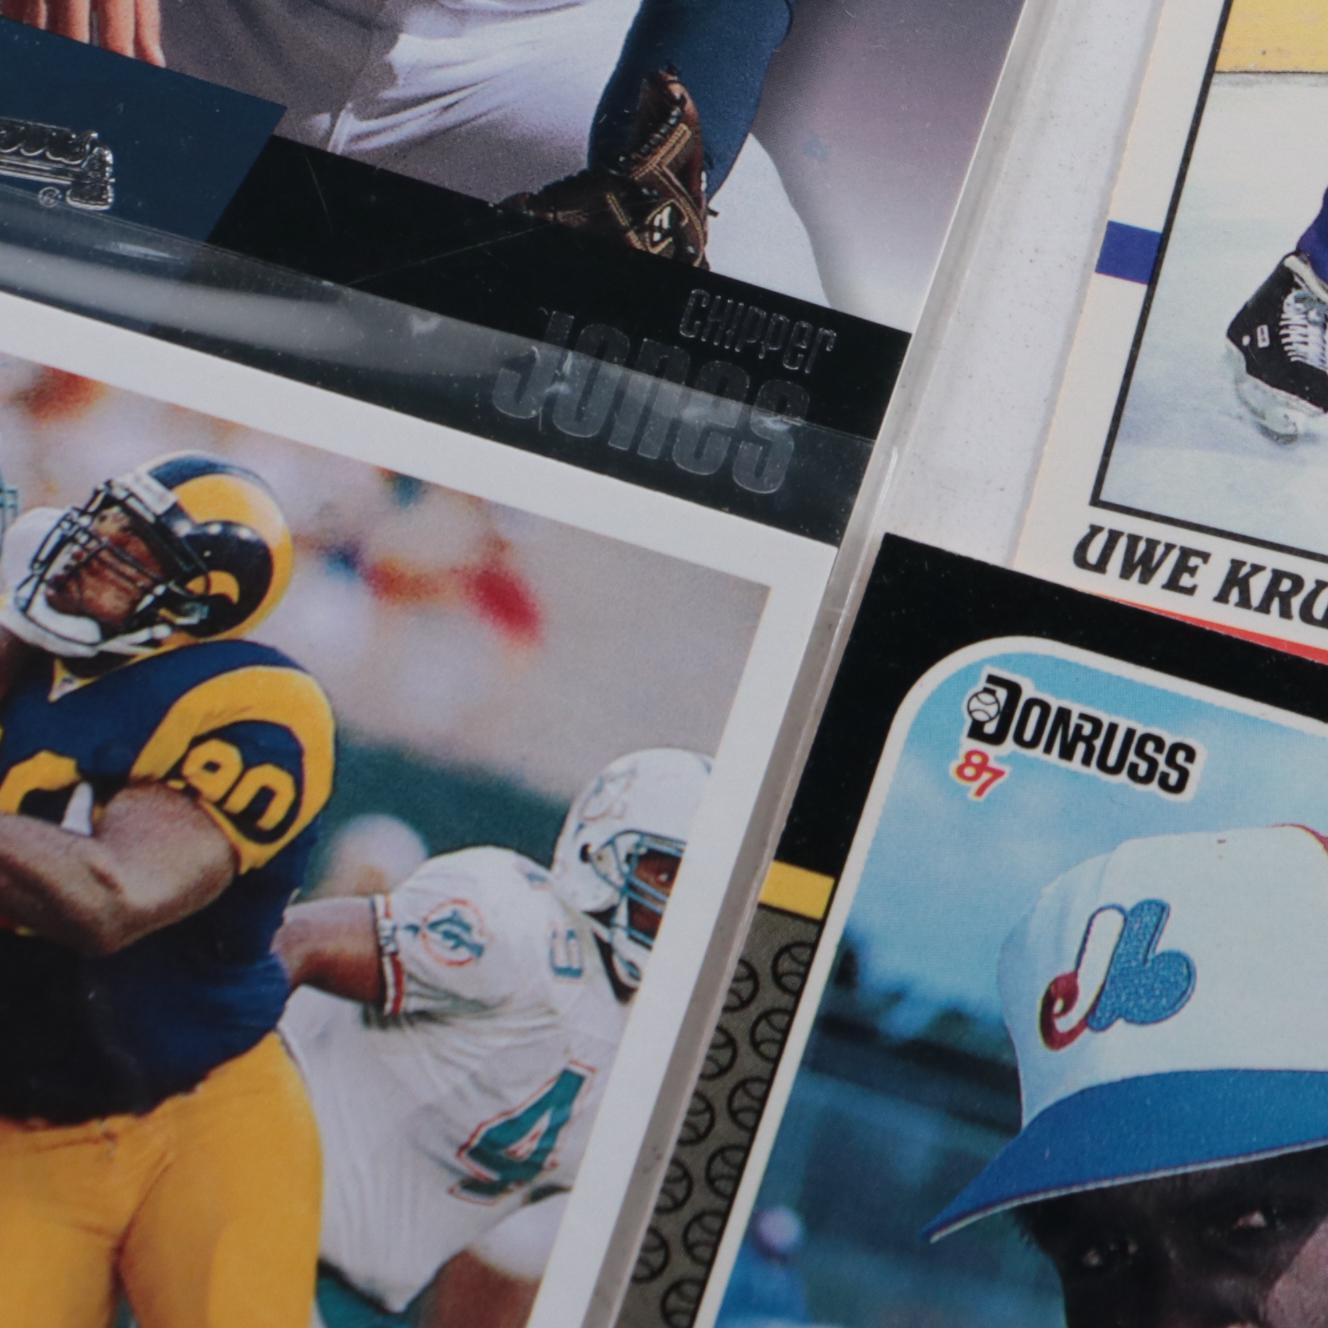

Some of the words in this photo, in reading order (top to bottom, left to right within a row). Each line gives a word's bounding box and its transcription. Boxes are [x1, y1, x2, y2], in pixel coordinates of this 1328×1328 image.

[1072, 523, 1212, 597] UWE
[967, 673, 1198, 795] DONRUSS
[955, 749, 1007, 799] 87
